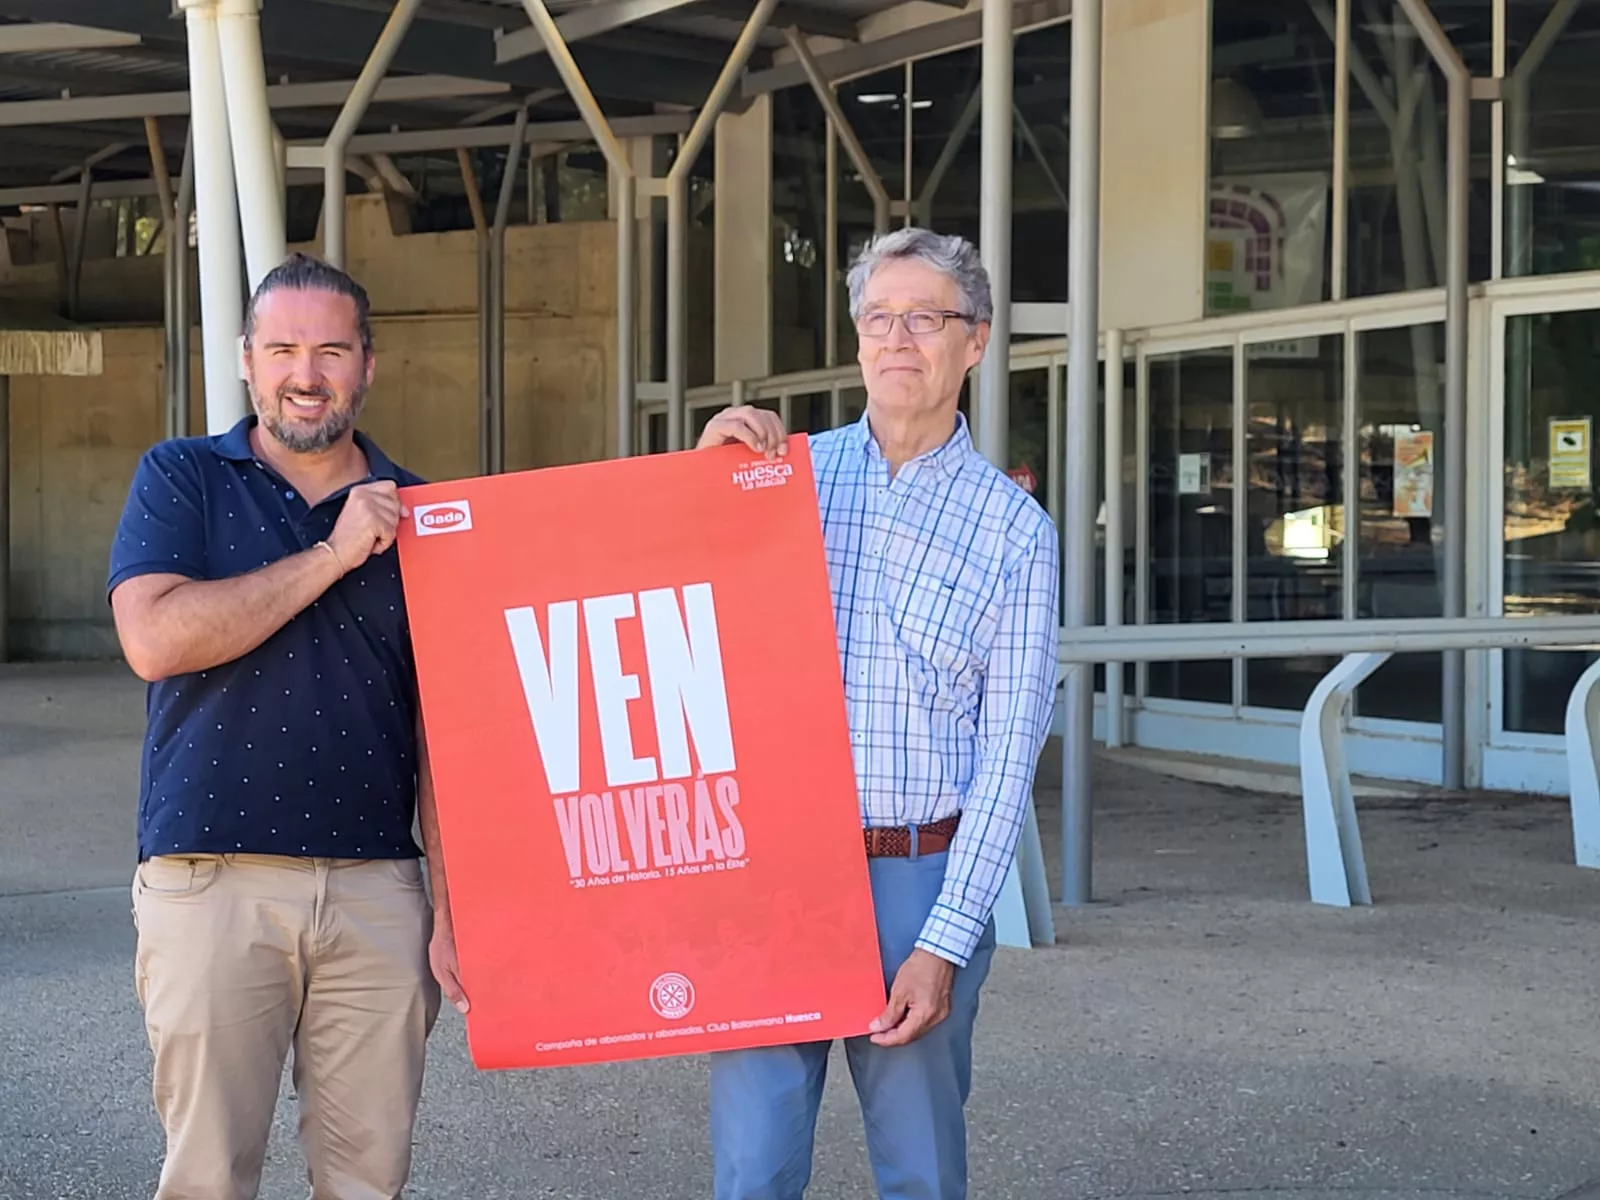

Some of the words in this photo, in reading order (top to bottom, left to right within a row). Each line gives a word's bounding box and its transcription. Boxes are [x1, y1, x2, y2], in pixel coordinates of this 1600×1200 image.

[732, 463, 793, 484] Huesca
[503, 582, 737, 795] VEN
[552, 768, 746, 879] VOLVERÁS
[587, 876, 610, 888] Años
[612, 873, 625, 885] de
[664, 866, 676, 878] 15
[677, 862, 700, 876] Años
[702, 863, 714, 873] en
[715, 861, 726, 871] la
[584, 1036, 598, 1047] de
[647, 1031, 654, 1041] y
[706, 1020, 730, 1033] Club
[785, 1011, 822, 1024] Huesca
